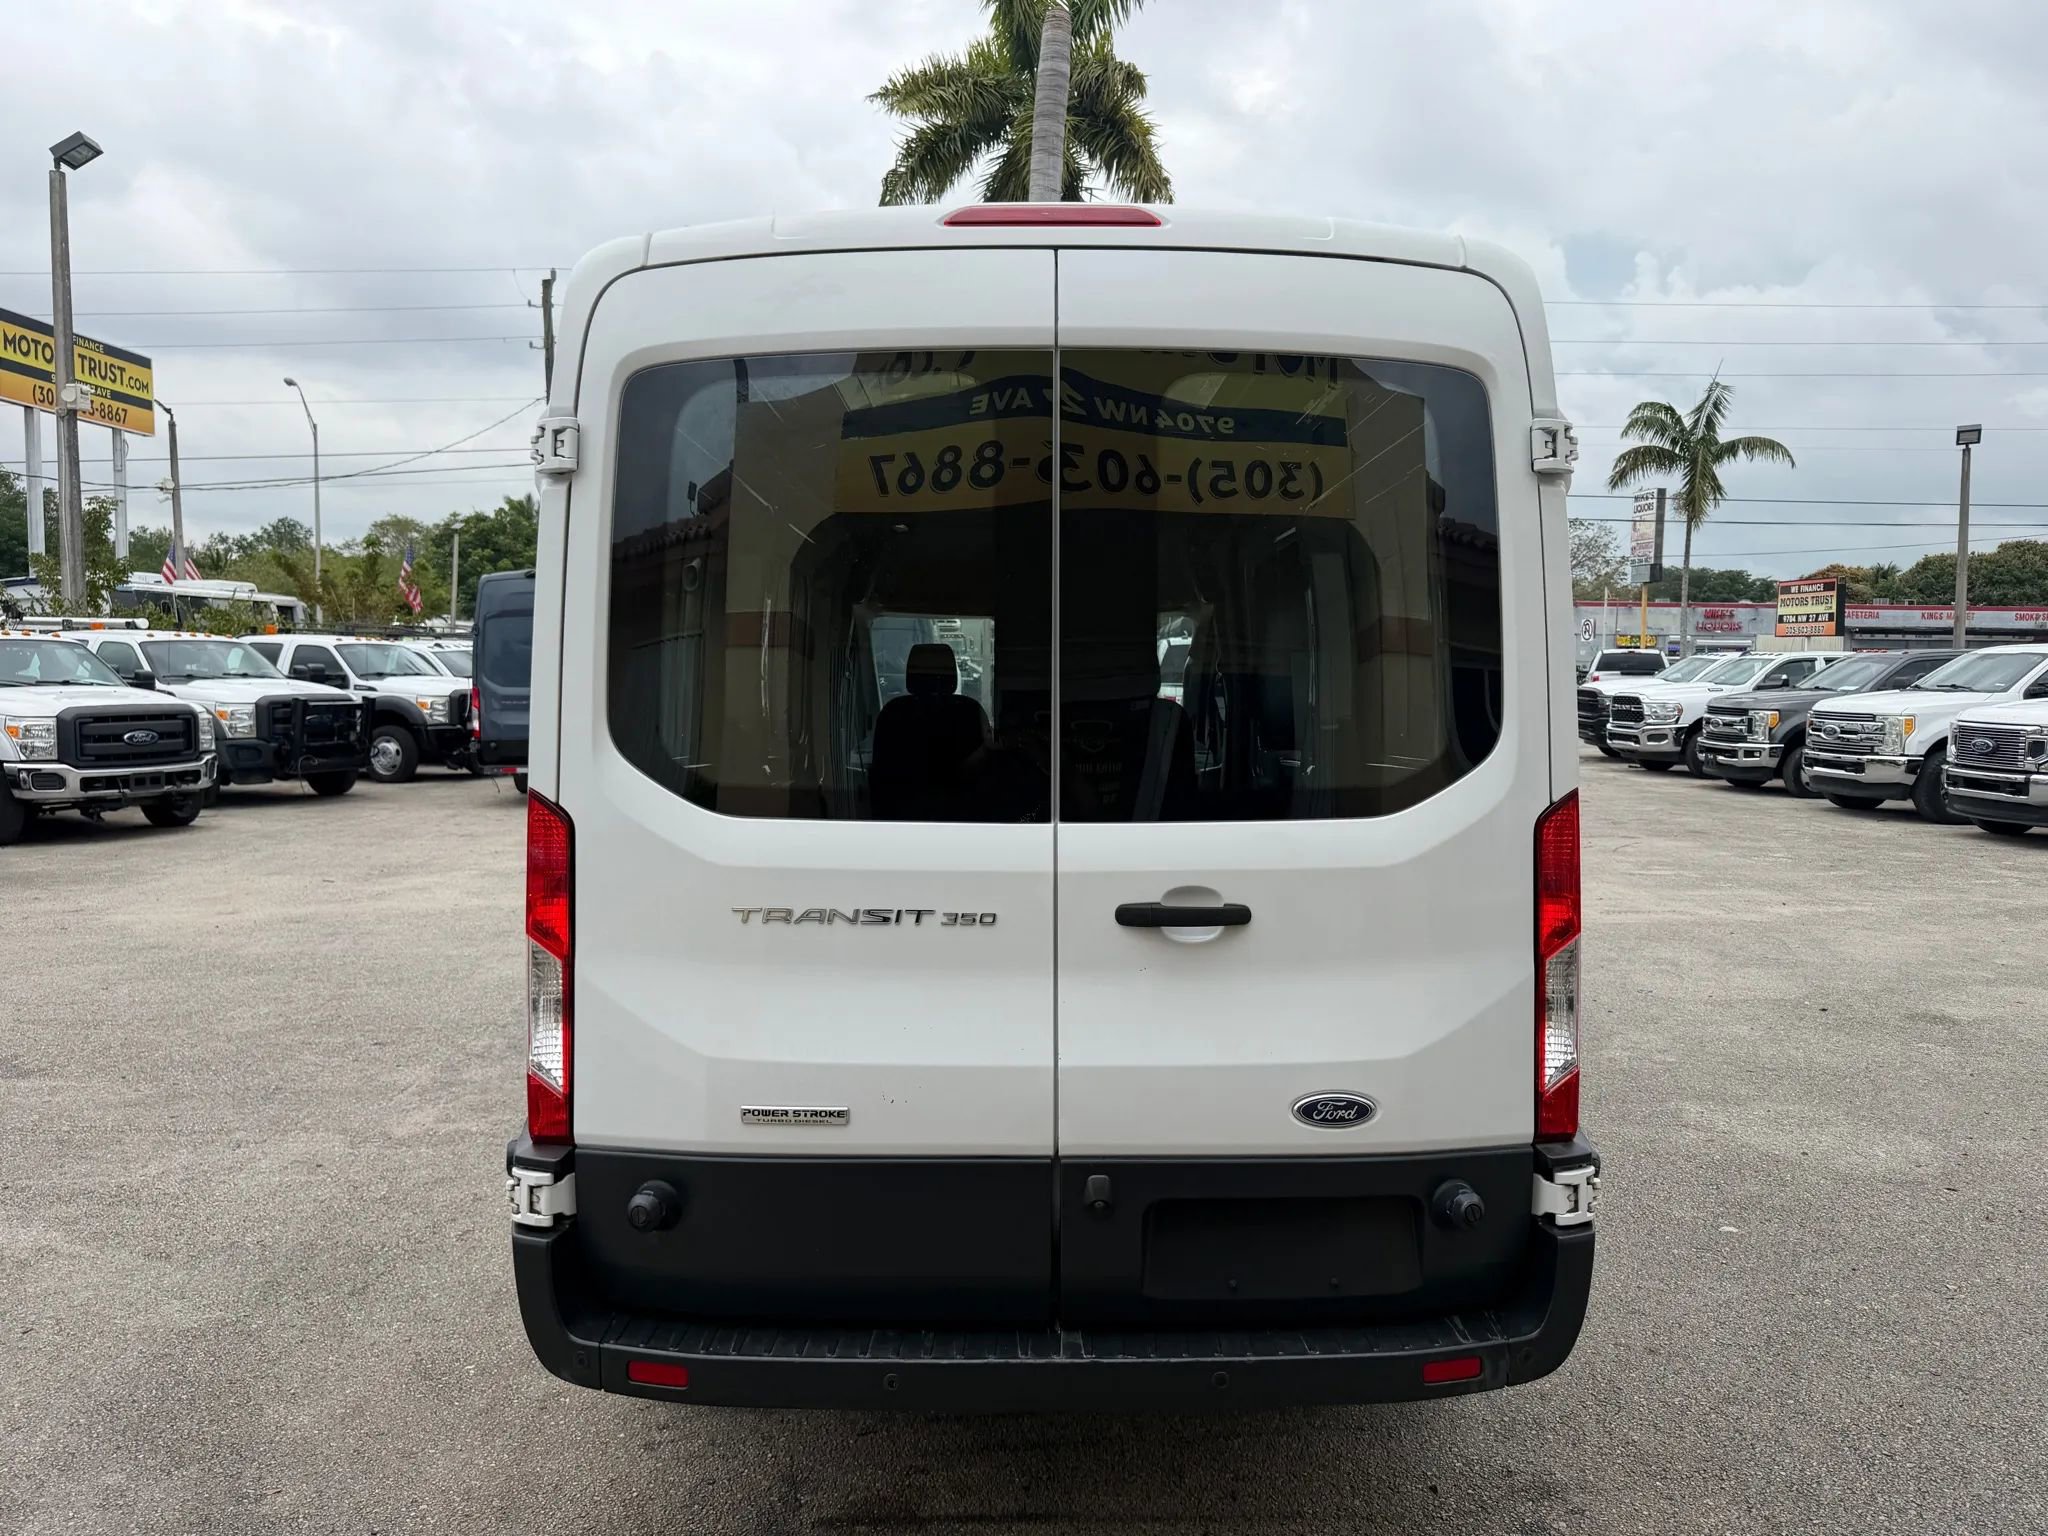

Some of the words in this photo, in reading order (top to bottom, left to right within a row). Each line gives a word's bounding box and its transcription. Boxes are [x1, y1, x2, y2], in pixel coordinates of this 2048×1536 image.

[73, 335, 104, 354] FINANCE
[3, 328, 55, 364] MOTO
[78, 353, 149, 395] TRUST.COM
[1780, 596, 1809, 607] MOTORS
[1810, 594, 1834, 606] TRUST
[1921, 612, 1944, 621] KINGS
[731, 907, 936, 925] TRANSIT
[941, 912, 997, 926] 350
[742, 1109, 789, 1118] POWER
[792, 1109, 846, 1119] STROKE
[1313, 1101, 1358, 1120] Ford
